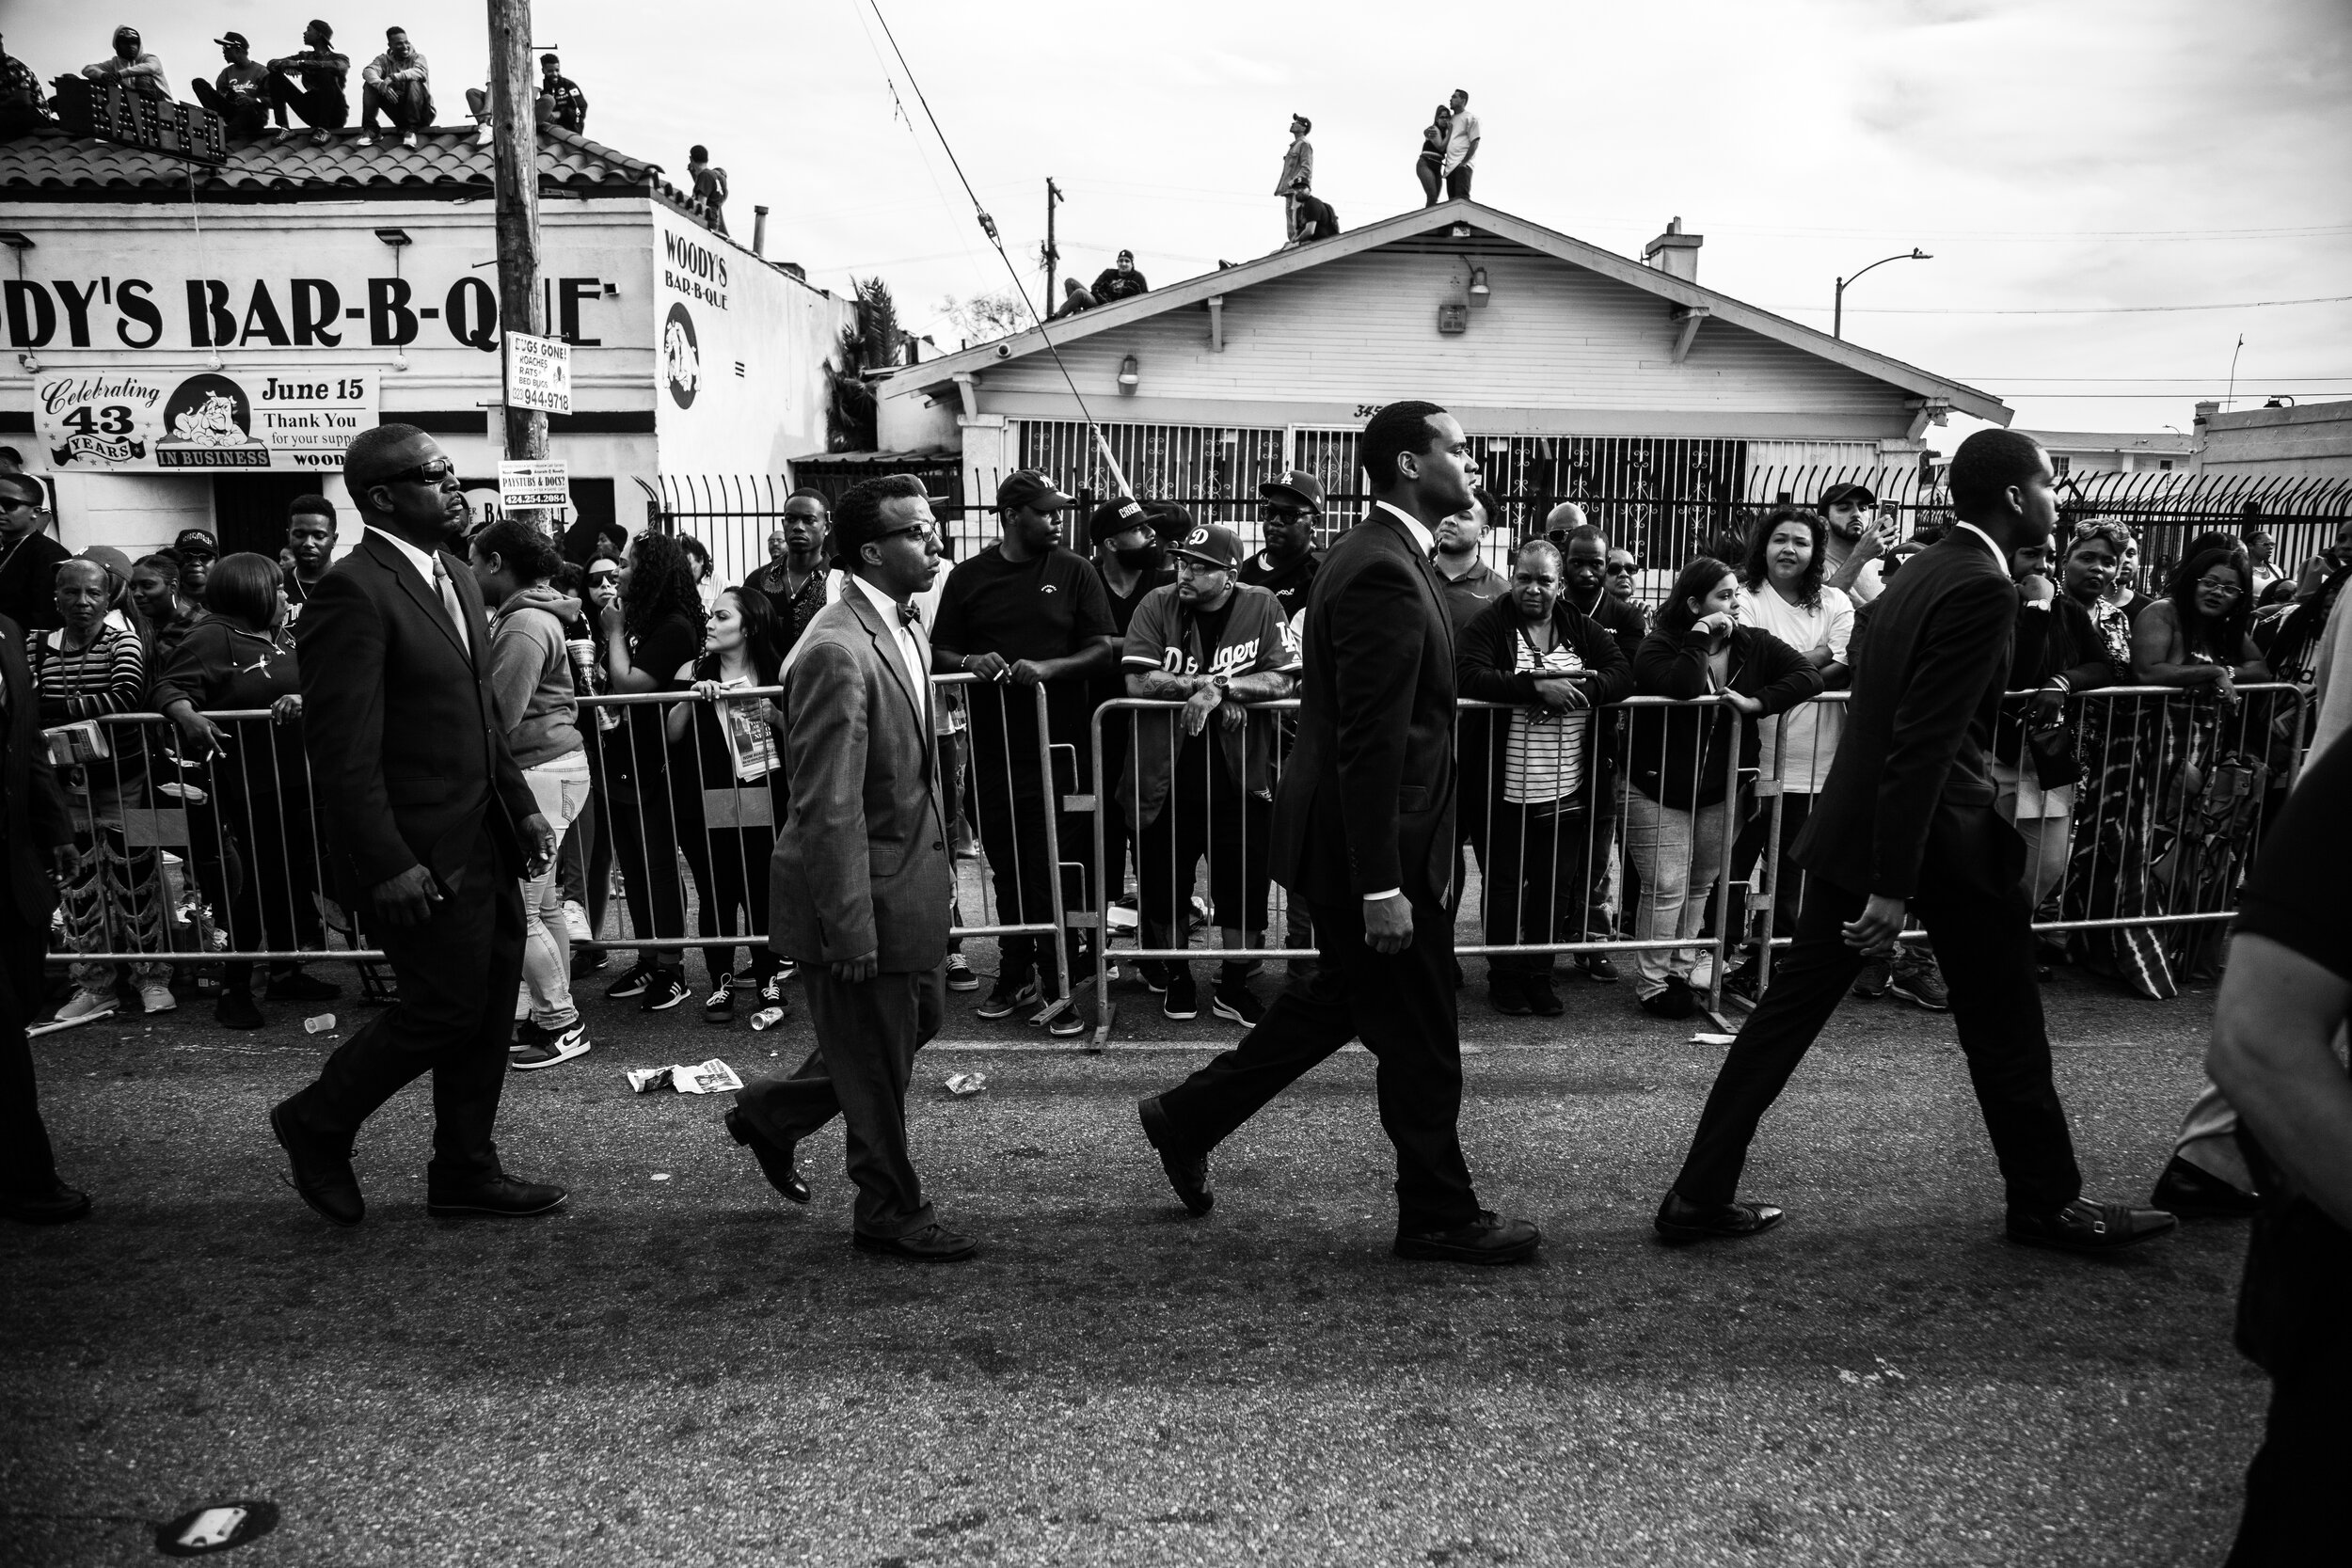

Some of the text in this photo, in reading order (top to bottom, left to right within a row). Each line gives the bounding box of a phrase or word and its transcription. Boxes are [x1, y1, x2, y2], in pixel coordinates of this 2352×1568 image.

[664, 229, 728, 288] WOODY'S
[540, 342, 566, 360] GONE!
[518, 355, 548, 370] ROACHES
[518, 366, 538, 377] RATS
[262, 377, 364, 401] June 15
[518, 376, 548, 388] BED BUGS
[41, 376, 161, 415] Celebrating
[62, 404, 135, 436] 43
[263, 413, 357, 428] Thank You
[71, 437, 130, 459] YEARS
[272, 432, 288, 444] for
[292, 435, 318, 449] your
[158, 451, 269, 466] IN BUSINESS
[502, 476, 565, 487] PAYSTUBS & DOCS?
[505, 494, 564, 504] 424.254.2084
[1188, 528, 1209, 546] D
[1275, 621, 1299, 653] LA
